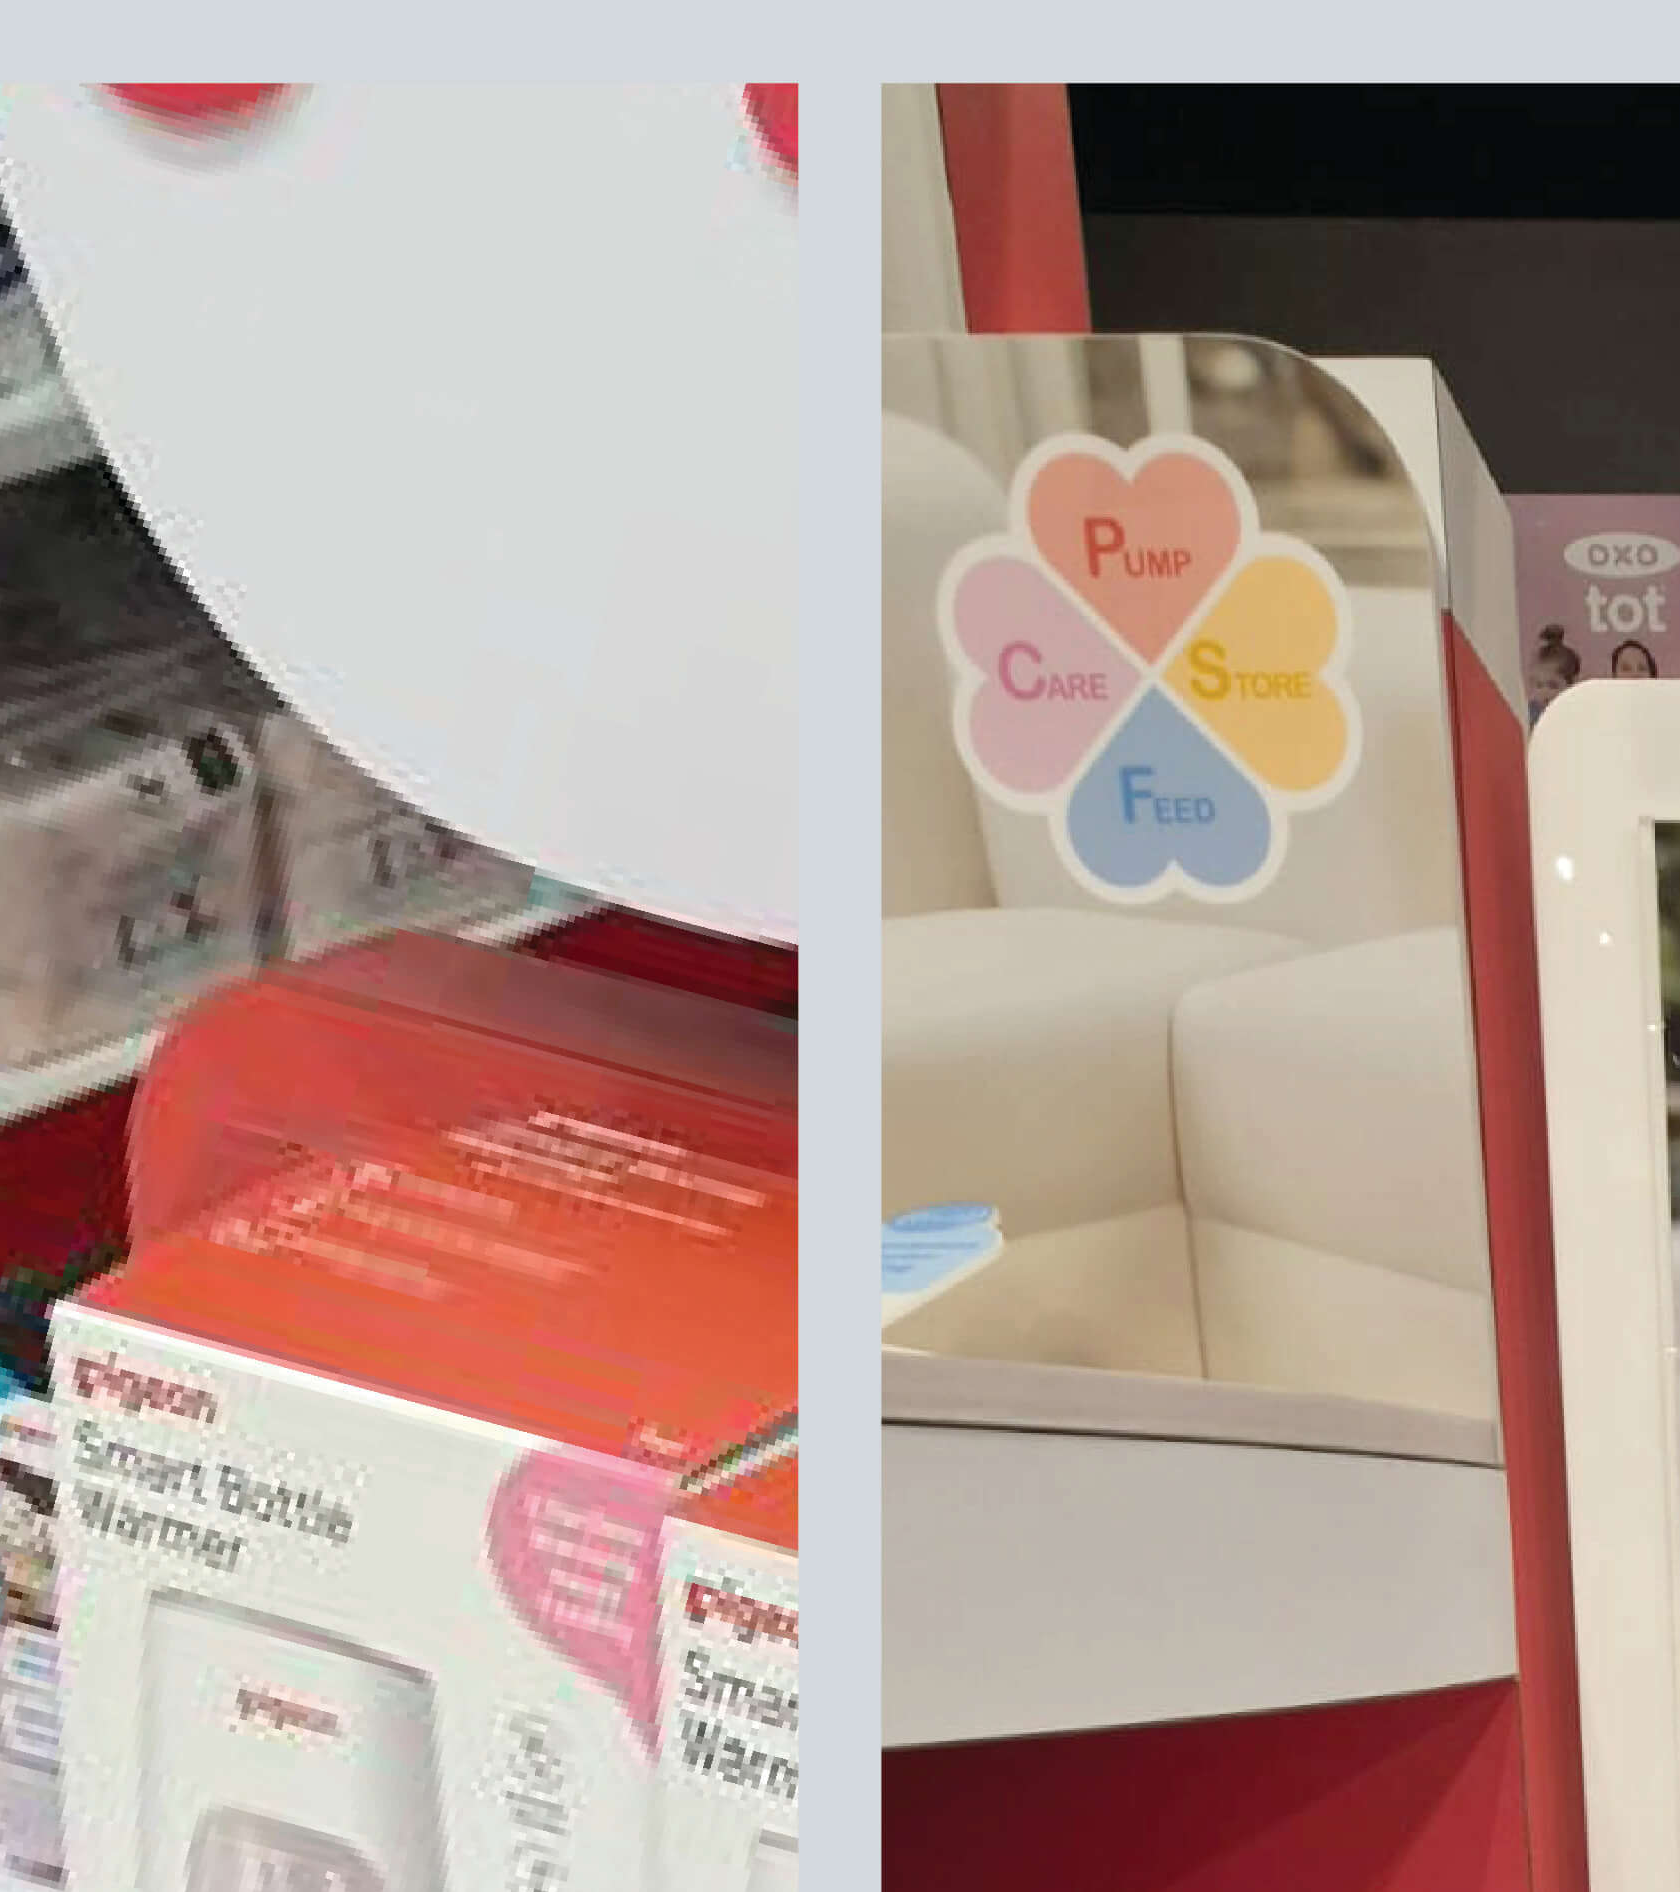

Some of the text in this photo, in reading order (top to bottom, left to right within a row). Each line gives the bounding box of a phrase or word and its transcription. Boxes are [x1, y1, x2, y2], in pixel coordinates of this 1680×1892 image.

[1587, 542, 1659, 567] OXO
[1584, 582, 1667, 634] tot
[74, 1420, 355, 1547] Smart Bottle
